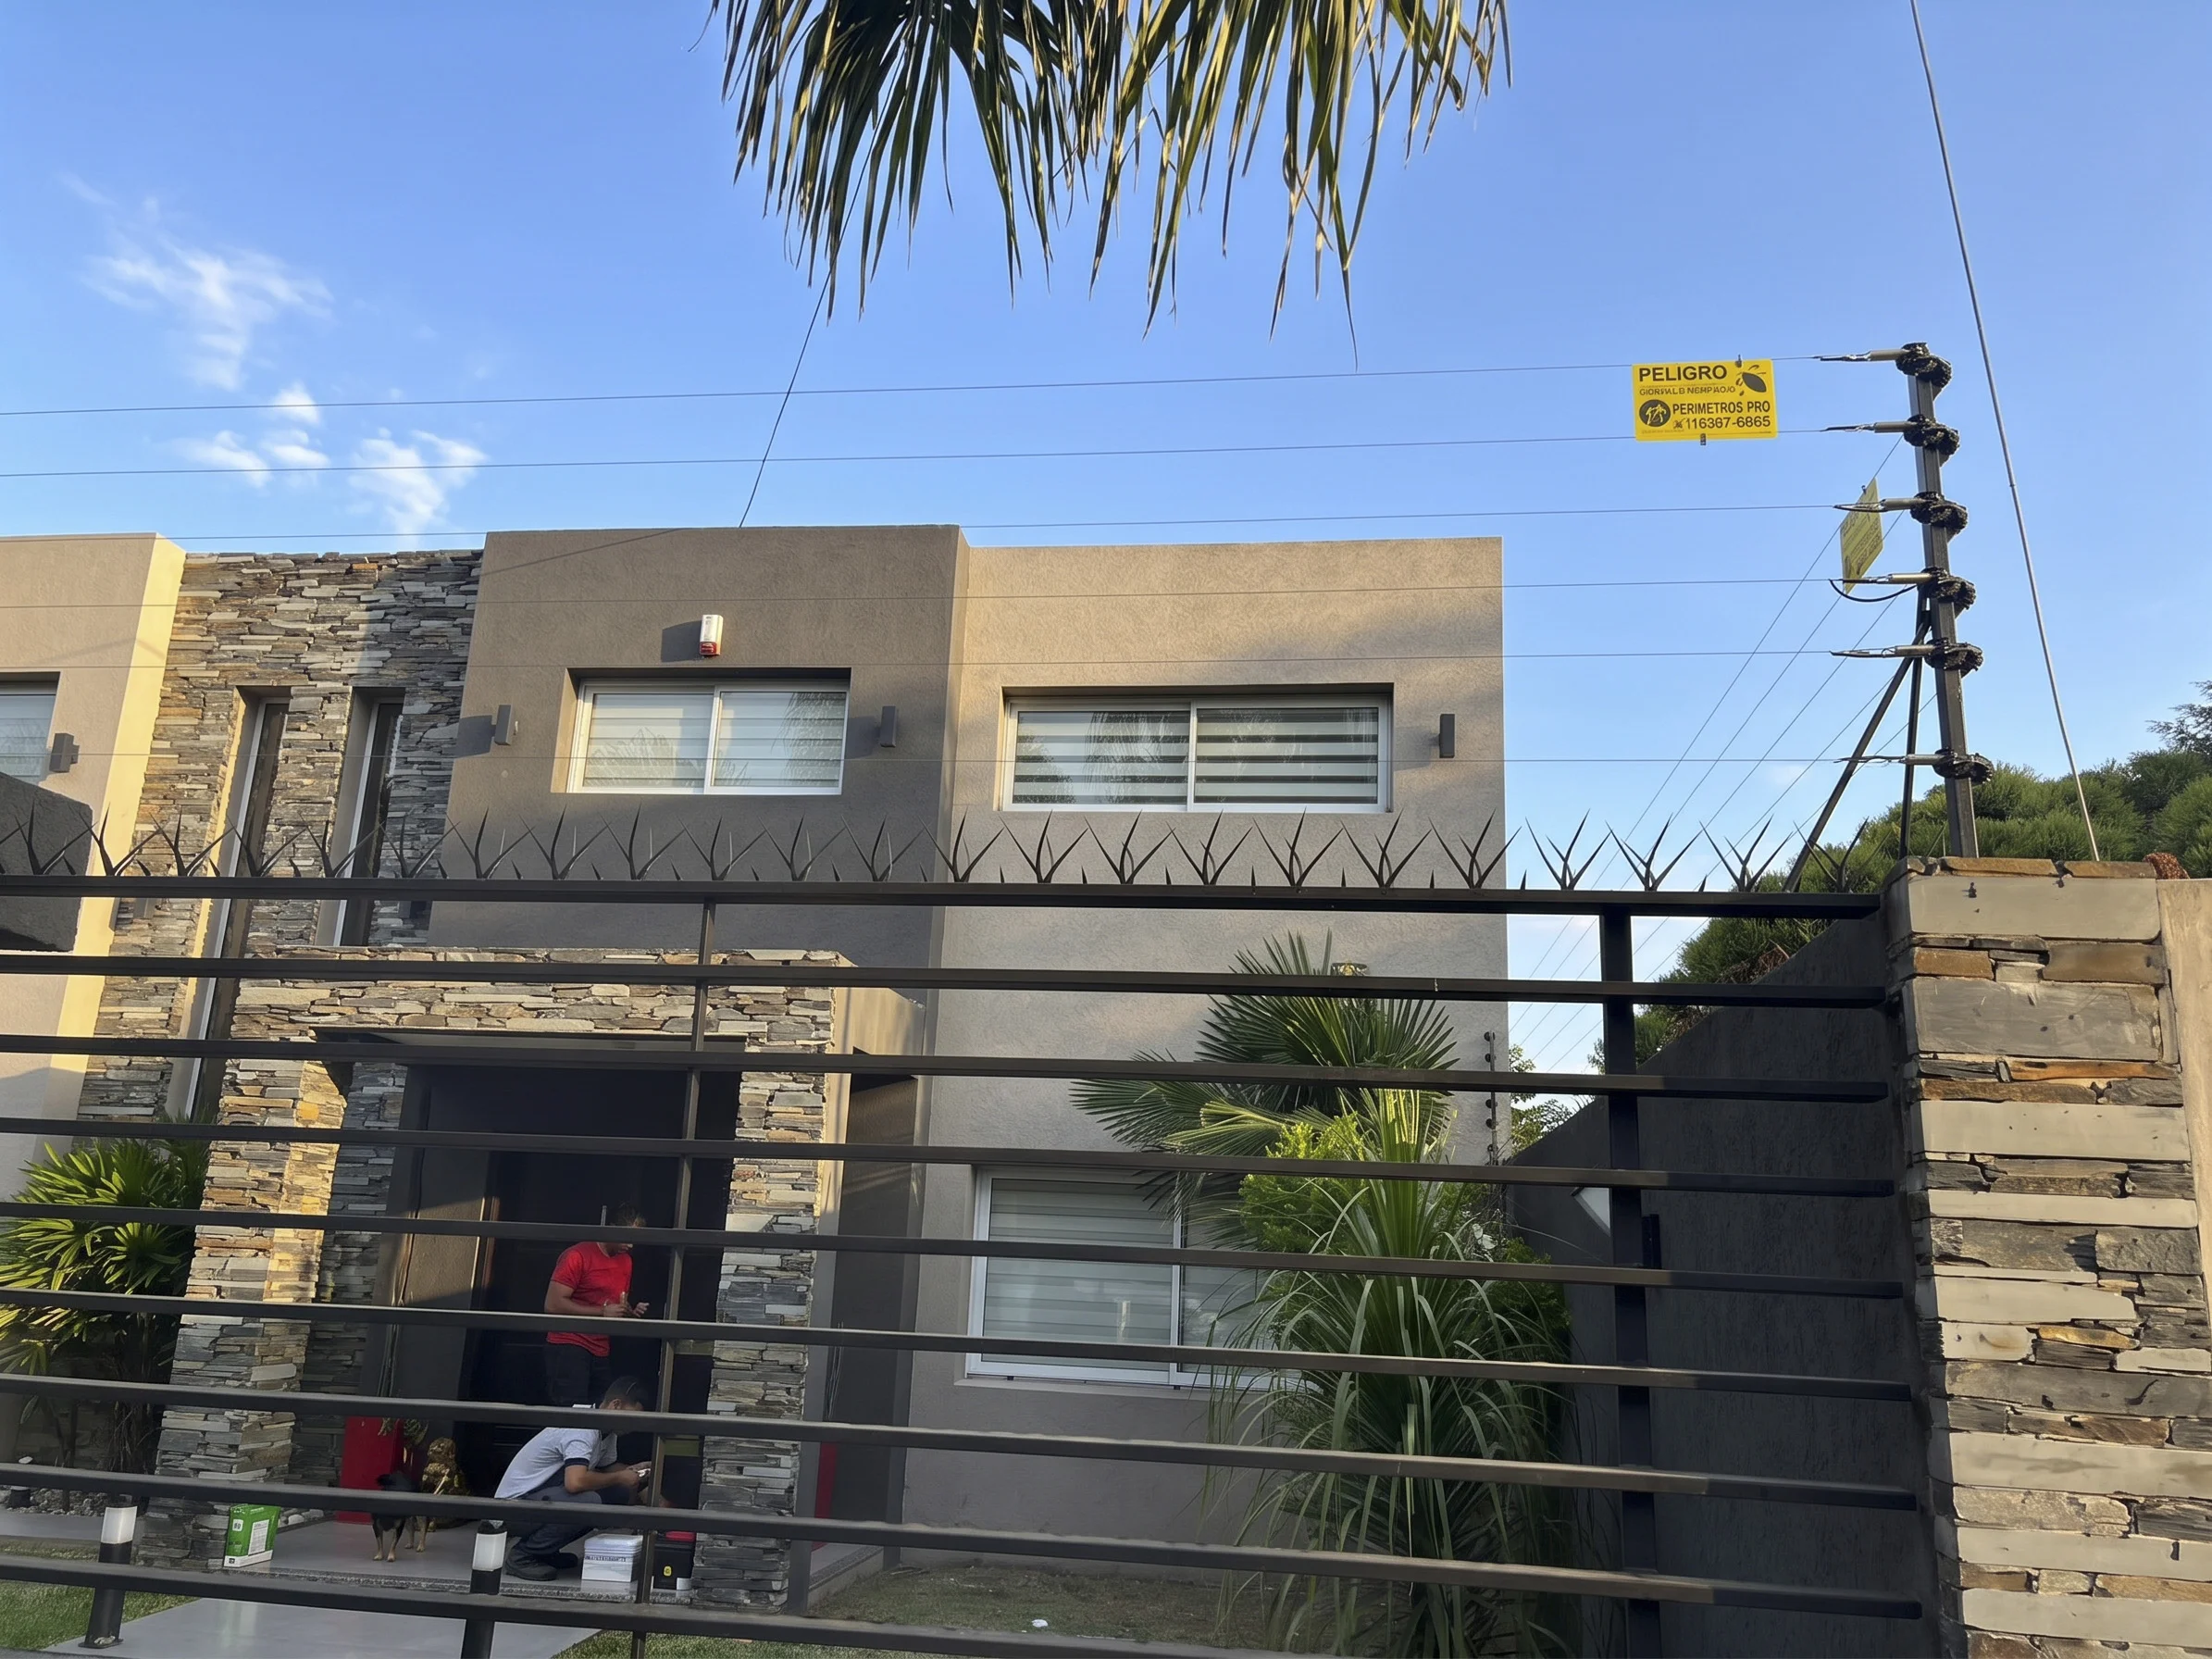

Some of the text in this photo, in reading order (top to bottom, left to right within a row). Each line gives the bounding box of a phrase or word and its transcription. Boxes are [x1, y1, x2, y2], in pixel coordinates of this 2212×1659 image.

[1639, 365, 1727, 381] PELIGRO
[1672, 401, 1771, 415] PERIMETROS PRO
